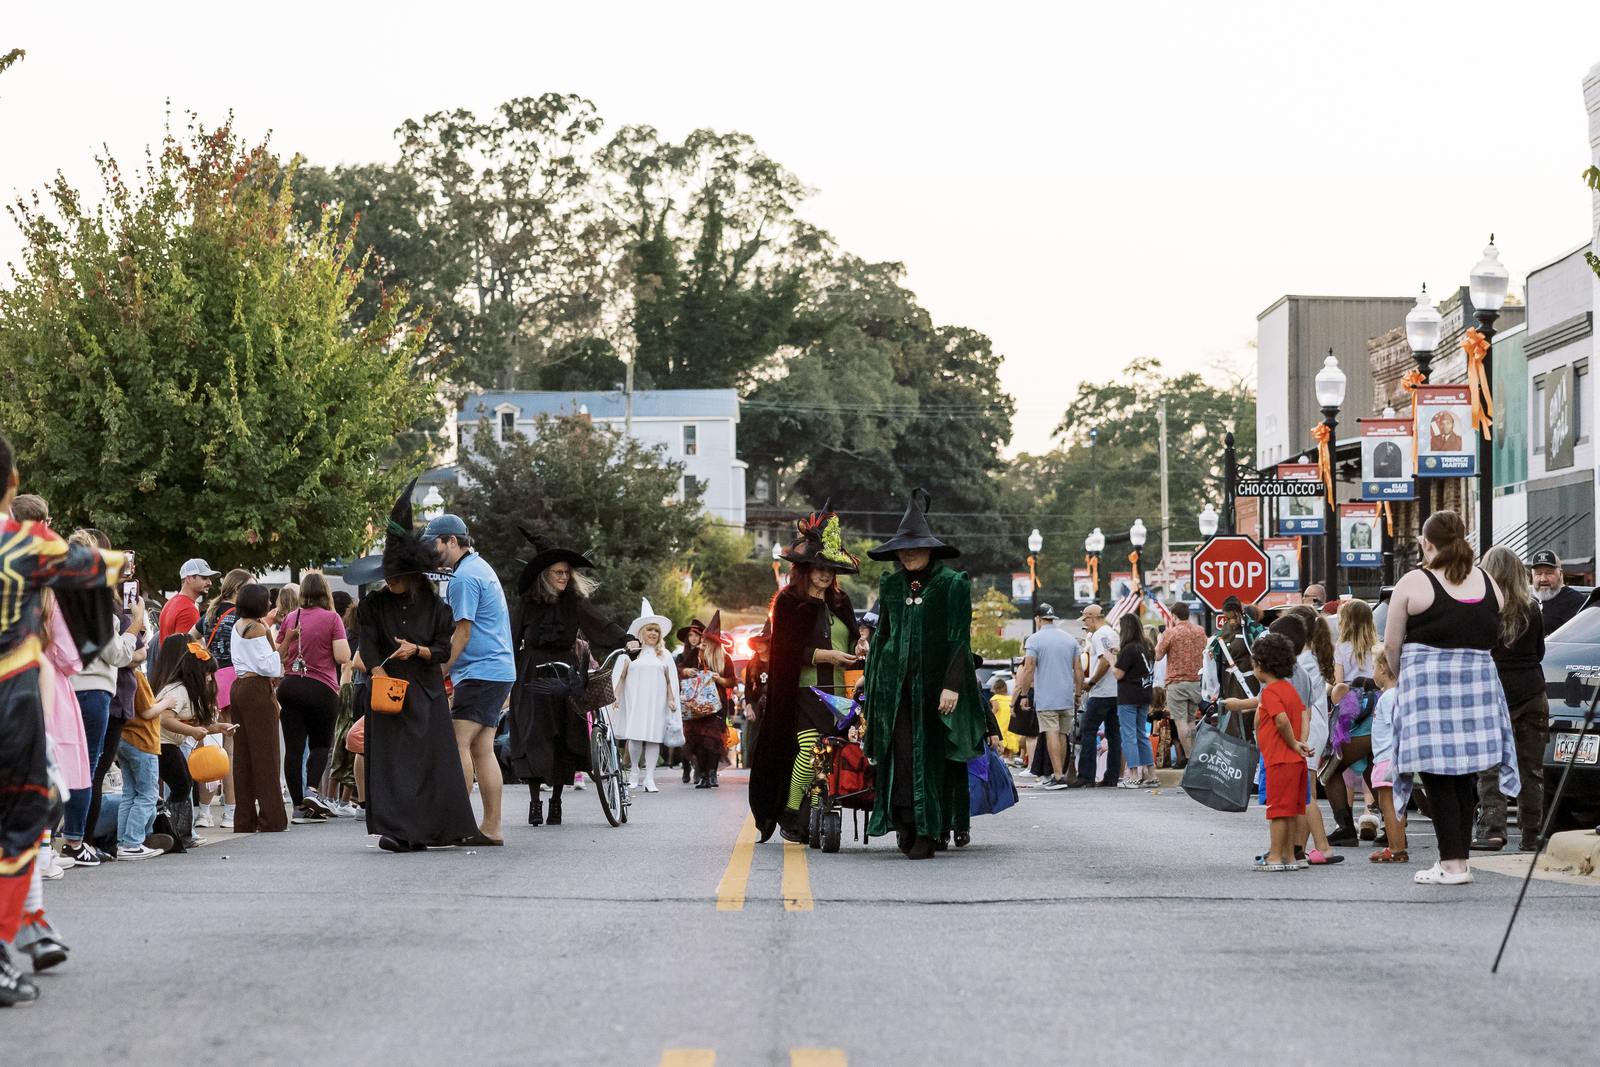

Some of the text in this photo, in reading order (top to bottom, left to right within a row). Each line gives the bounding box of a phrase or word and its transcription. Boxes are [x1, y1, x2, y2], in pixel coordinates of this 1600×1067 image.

[1238, 483, 1315, 495] CHOCCOLOCCO
[1199, 561, 1262, 588] STOP
[1199, 753, 1242, 779] OXFORD
